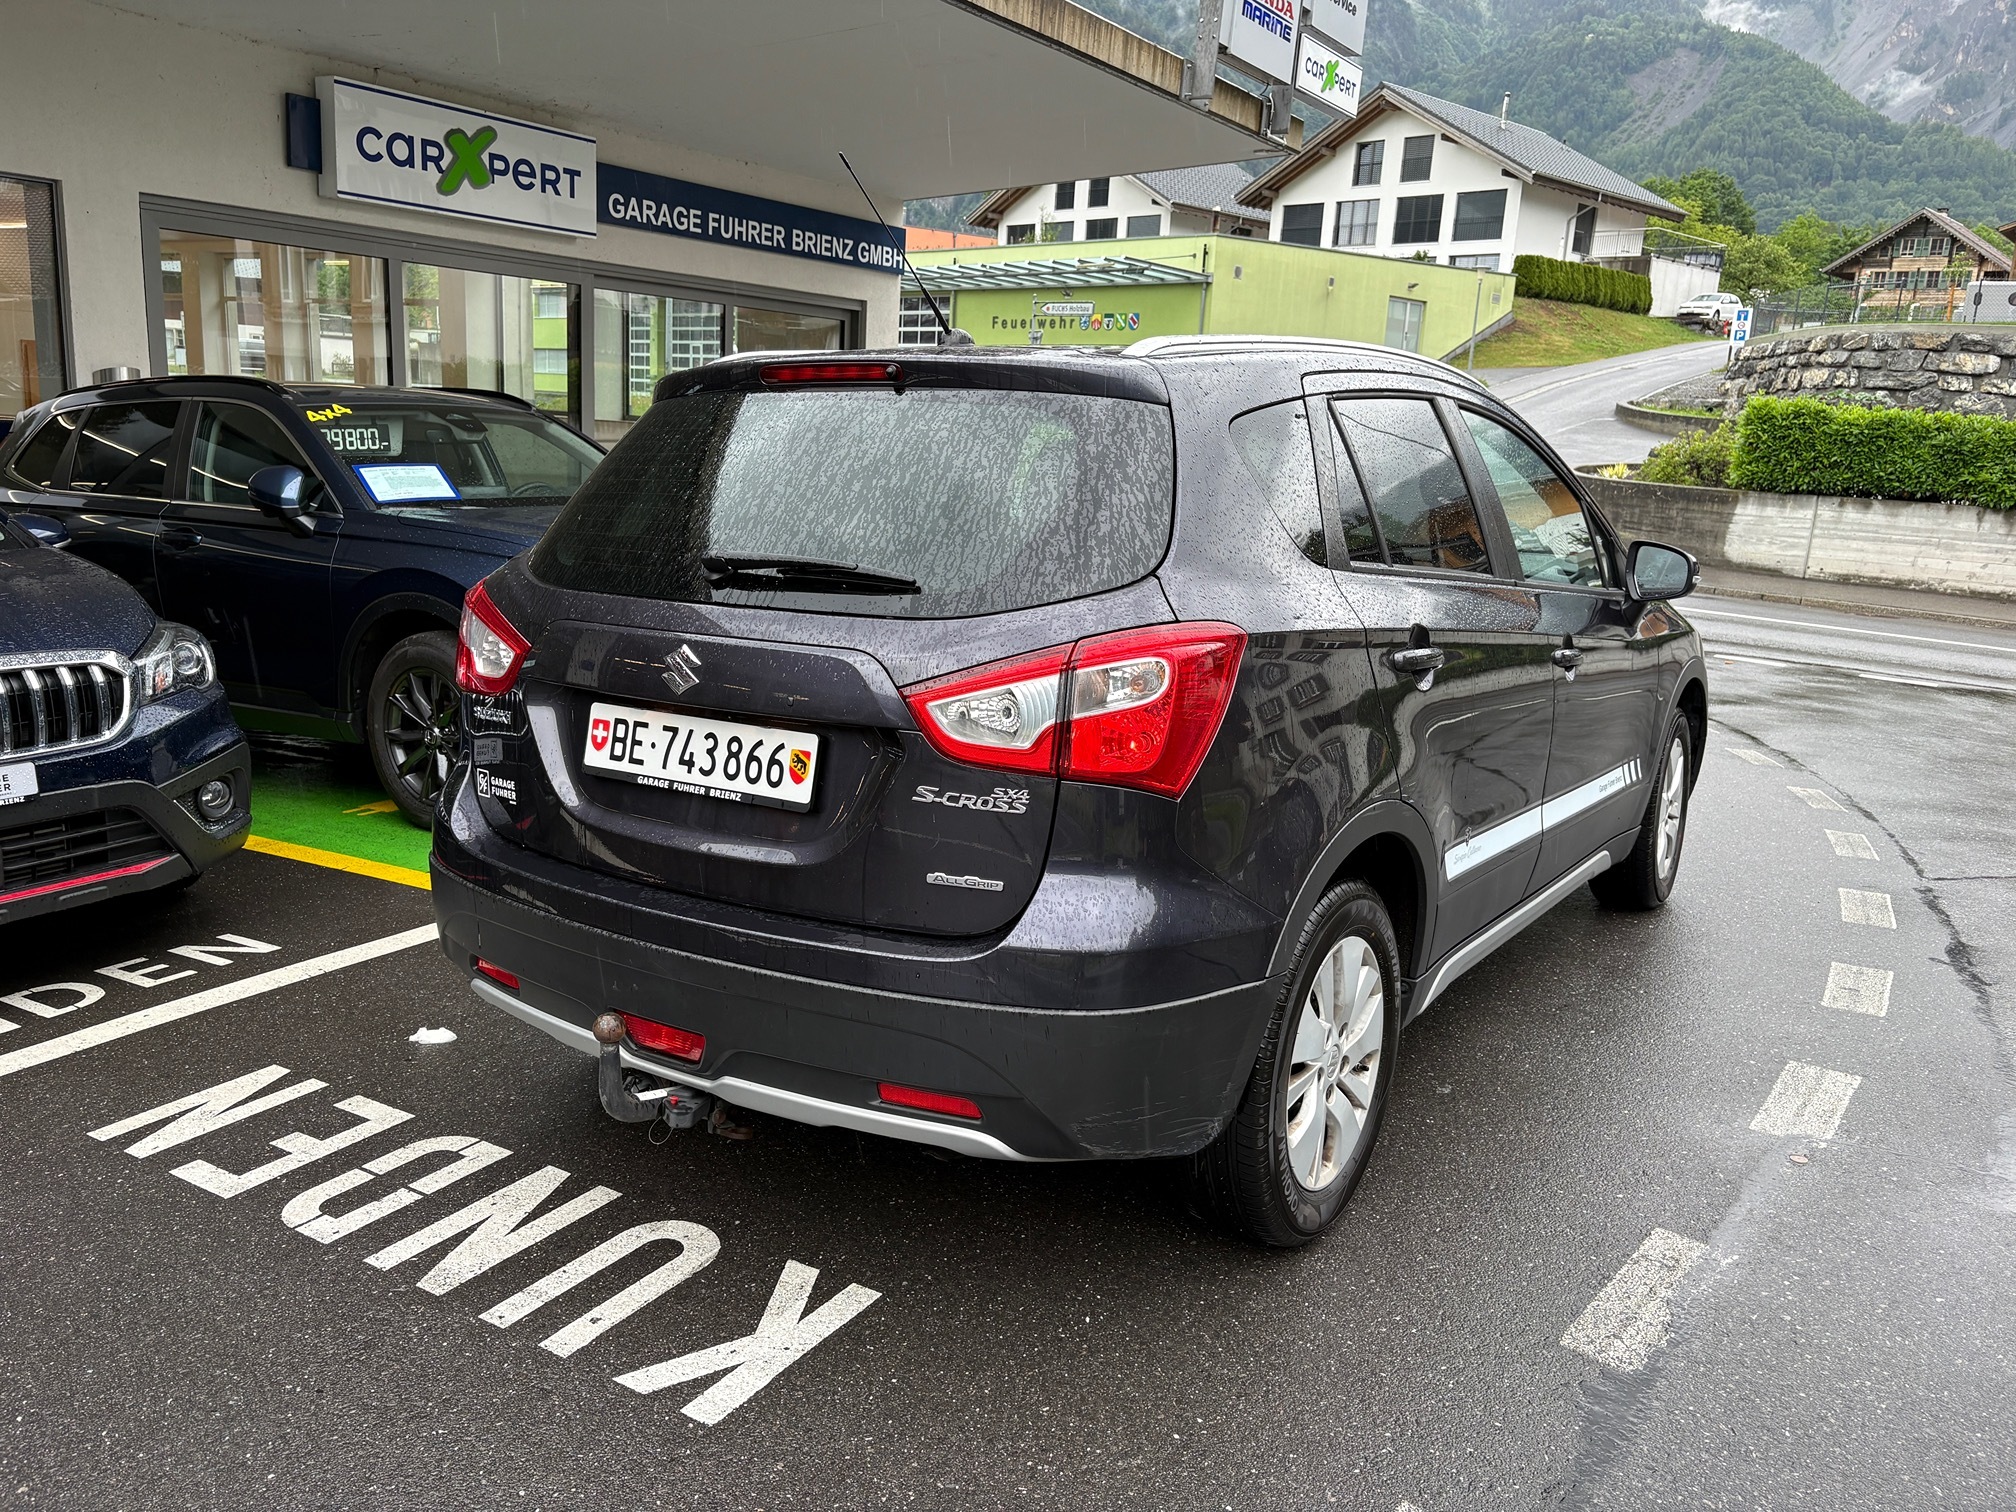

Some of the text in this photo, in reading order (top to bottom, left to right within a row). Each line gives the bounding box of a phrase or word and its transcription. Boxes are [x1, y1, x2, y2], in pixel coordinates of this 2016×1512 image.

[1241, 0, 1292, 43] MARINE
[608, 193, 904, 270] GARAGE FUHRER BRIENZ GMBH
[1736, 331, 1744, 340] P
[306, 404, 353, 422] 4x4
[473, 705, 512, 725] SUZUKI
[490, 776, 516, 790] GARAGE
[491, 786, 517, 800] FUHRER
[637, 775, 742, 802] GARAGE FUHRER BRIENZ
[0, 797, 26, 806] RIENZ
[911, 785, 1030, 815] S-CROSS
[990, 787, 1031, 801] SX4
[0, 933, 283, 1034] DEN
[86, 1064, 883, 1426] KUNDEN
